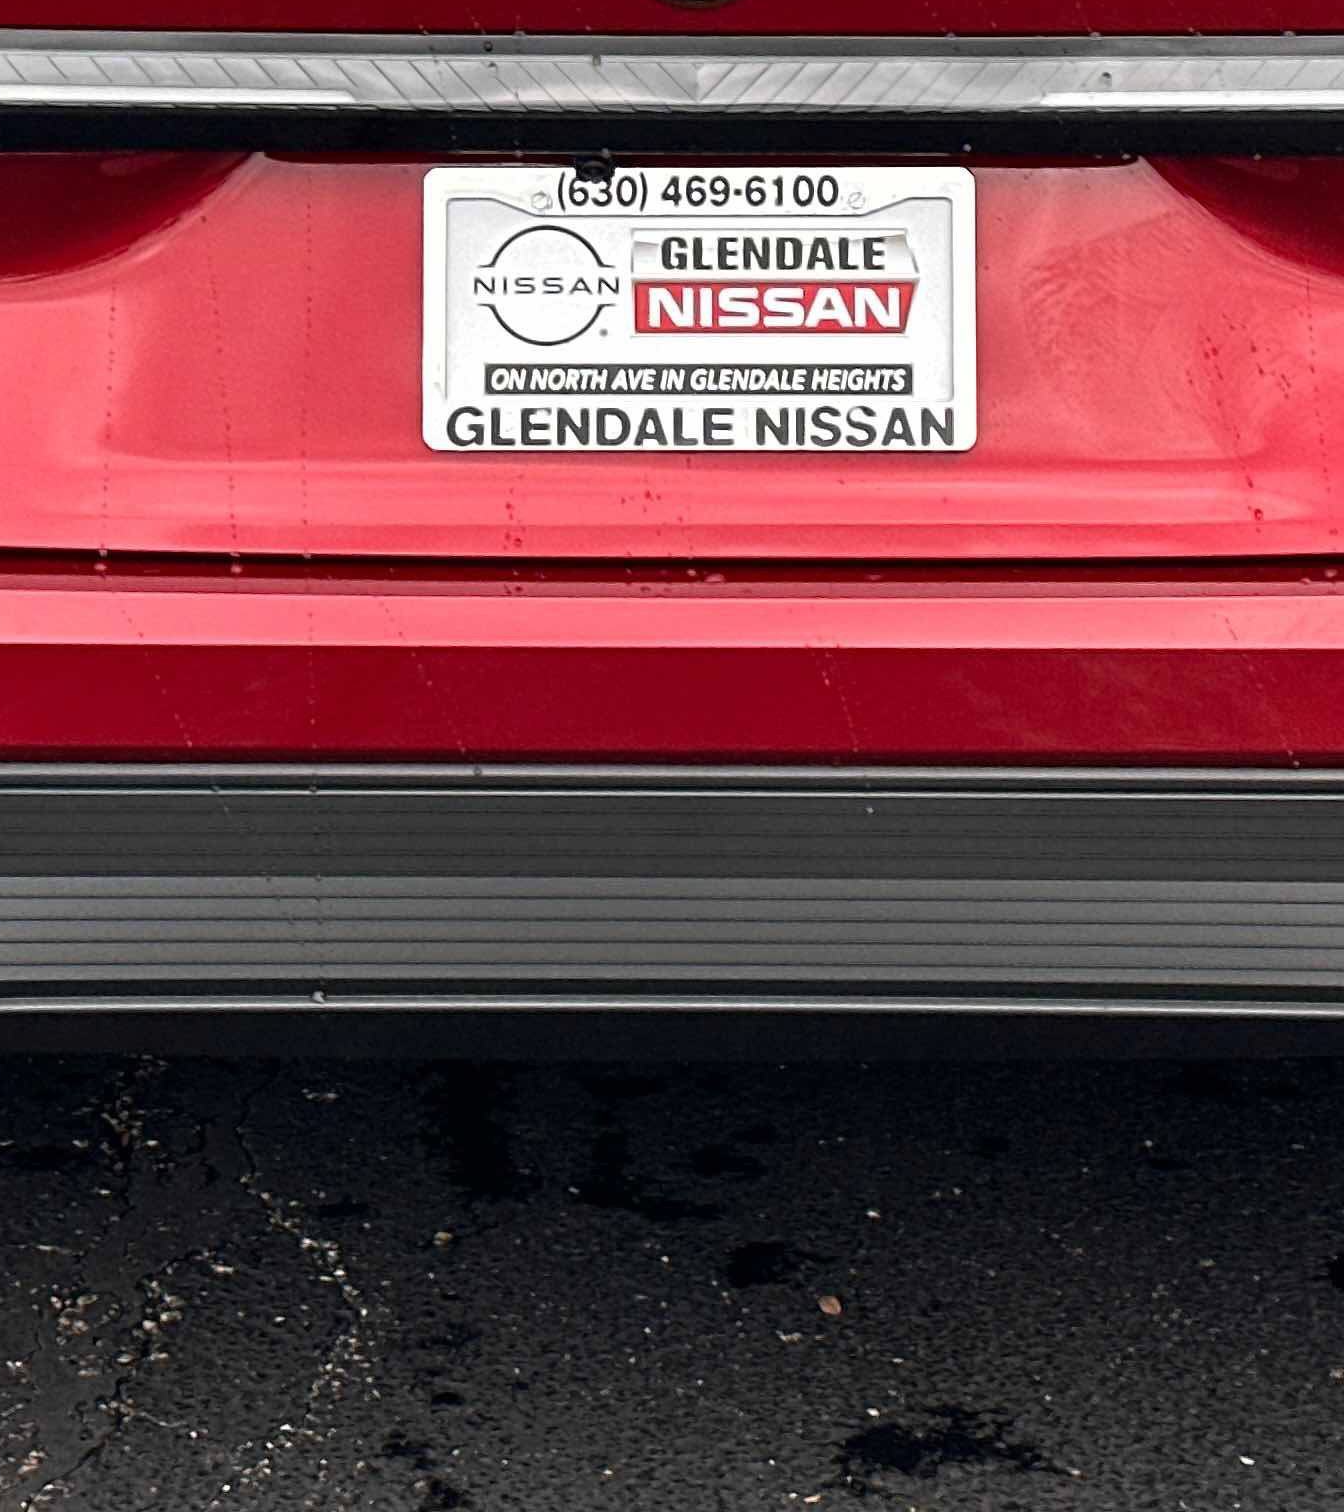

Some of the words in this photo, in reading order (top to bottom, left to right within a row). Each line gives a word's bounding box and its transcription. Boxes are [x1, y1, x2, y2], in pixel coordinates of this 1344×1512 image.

[557, 171, 649, 213] (630)
[660, 174, 840, 207] 469-6100
[660, 235, 887, 271] GLENDALE
[473, 276, 620, 296] NISSAN
[647, 286, 901, 329] NISSAN
[490, 367, 527, 391] ON
[529, 367, 608, 391] NORTH
[610, 367, 657, 391] AVE
[659, 367, 686, 391] IN
[689, 367, 807, 391] GLENDALE
[810, 367, 906, 391] HEIGHTS
[446, 405, 735, 447] GLENDALE
[755, 405, 955, 448] NISSAN
